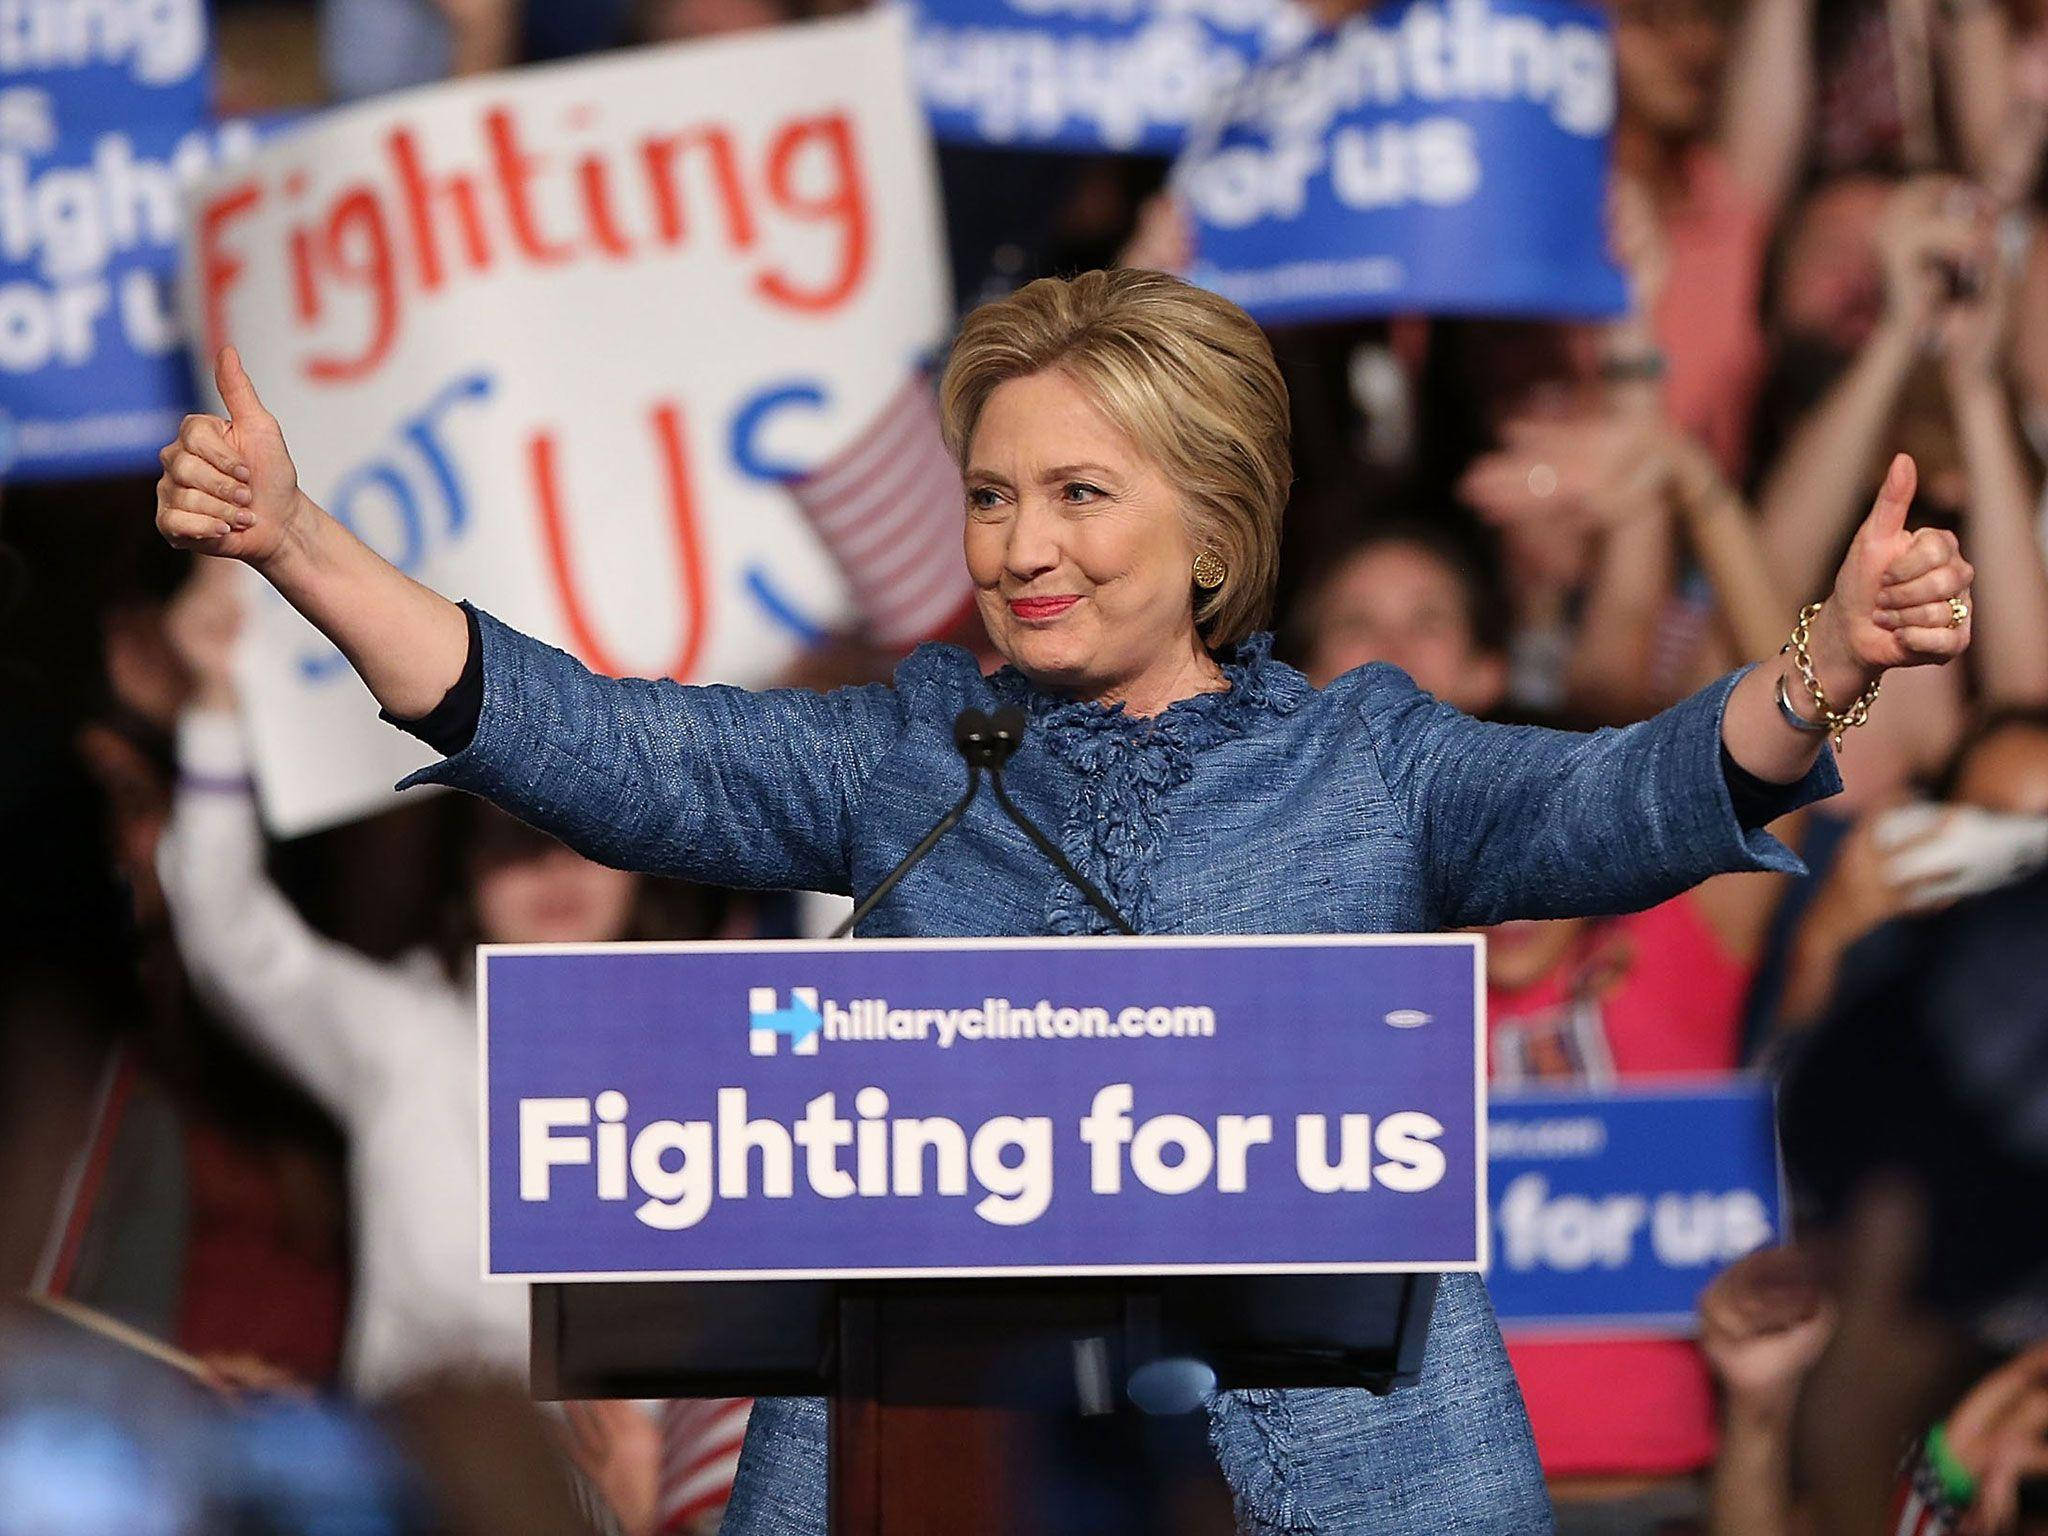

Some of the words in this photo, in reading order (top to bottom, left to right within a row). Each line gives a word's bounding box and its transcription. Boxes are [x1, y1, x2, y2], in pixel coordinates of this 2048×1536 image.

[1182, 128, 1322, 228] or
[1334, 117, 1480, 206] us
[196, 98, 872, 386] Fighting
[822, 998, 1216, 1049] hillaryclinton.com
[519, 1086, 1054, 1231] Fighting
[1079, 1083, 1273, 1196] for
[1295, 1111, 1447, 1194] us
[1502, 1172, 1652, 1272] for
[1652, 1189, 1771, 1268] us
